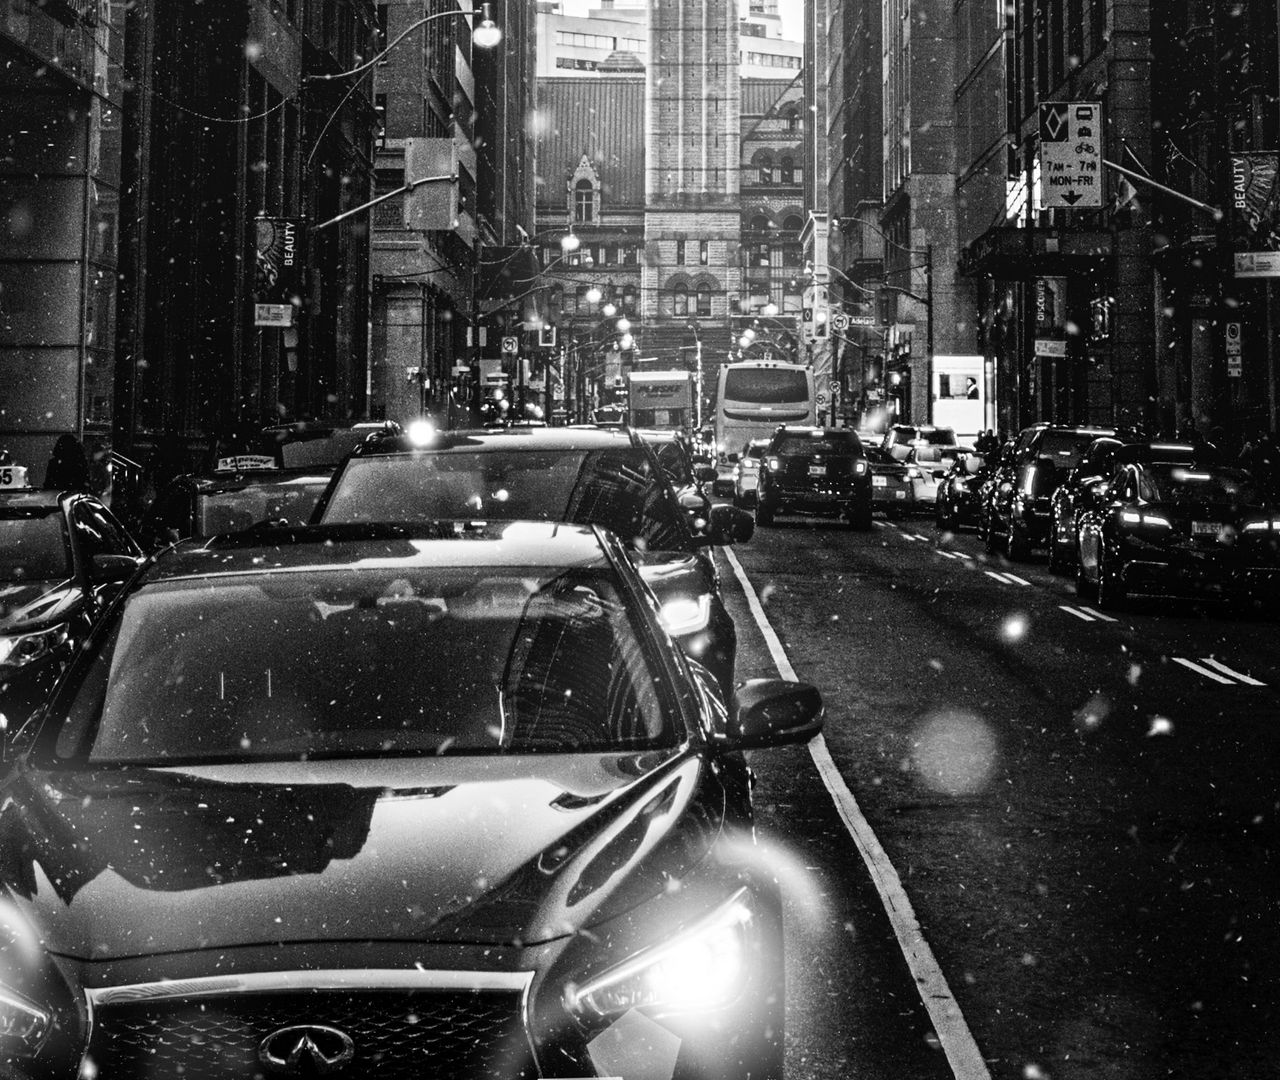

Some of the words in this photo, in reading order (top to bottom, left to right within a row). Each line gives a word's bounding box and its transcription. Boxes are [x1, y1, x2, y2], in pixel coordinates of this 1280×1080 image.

[1049, 175, 1094, 186] MON-FRI
[1232, 157, 1246, 209] BEAUTY
[283, 221, 296, 266] BEAUTY
[850, 316, 876, 325] Adelaid
[1036, 279, 1046, 321] DISCOVER
